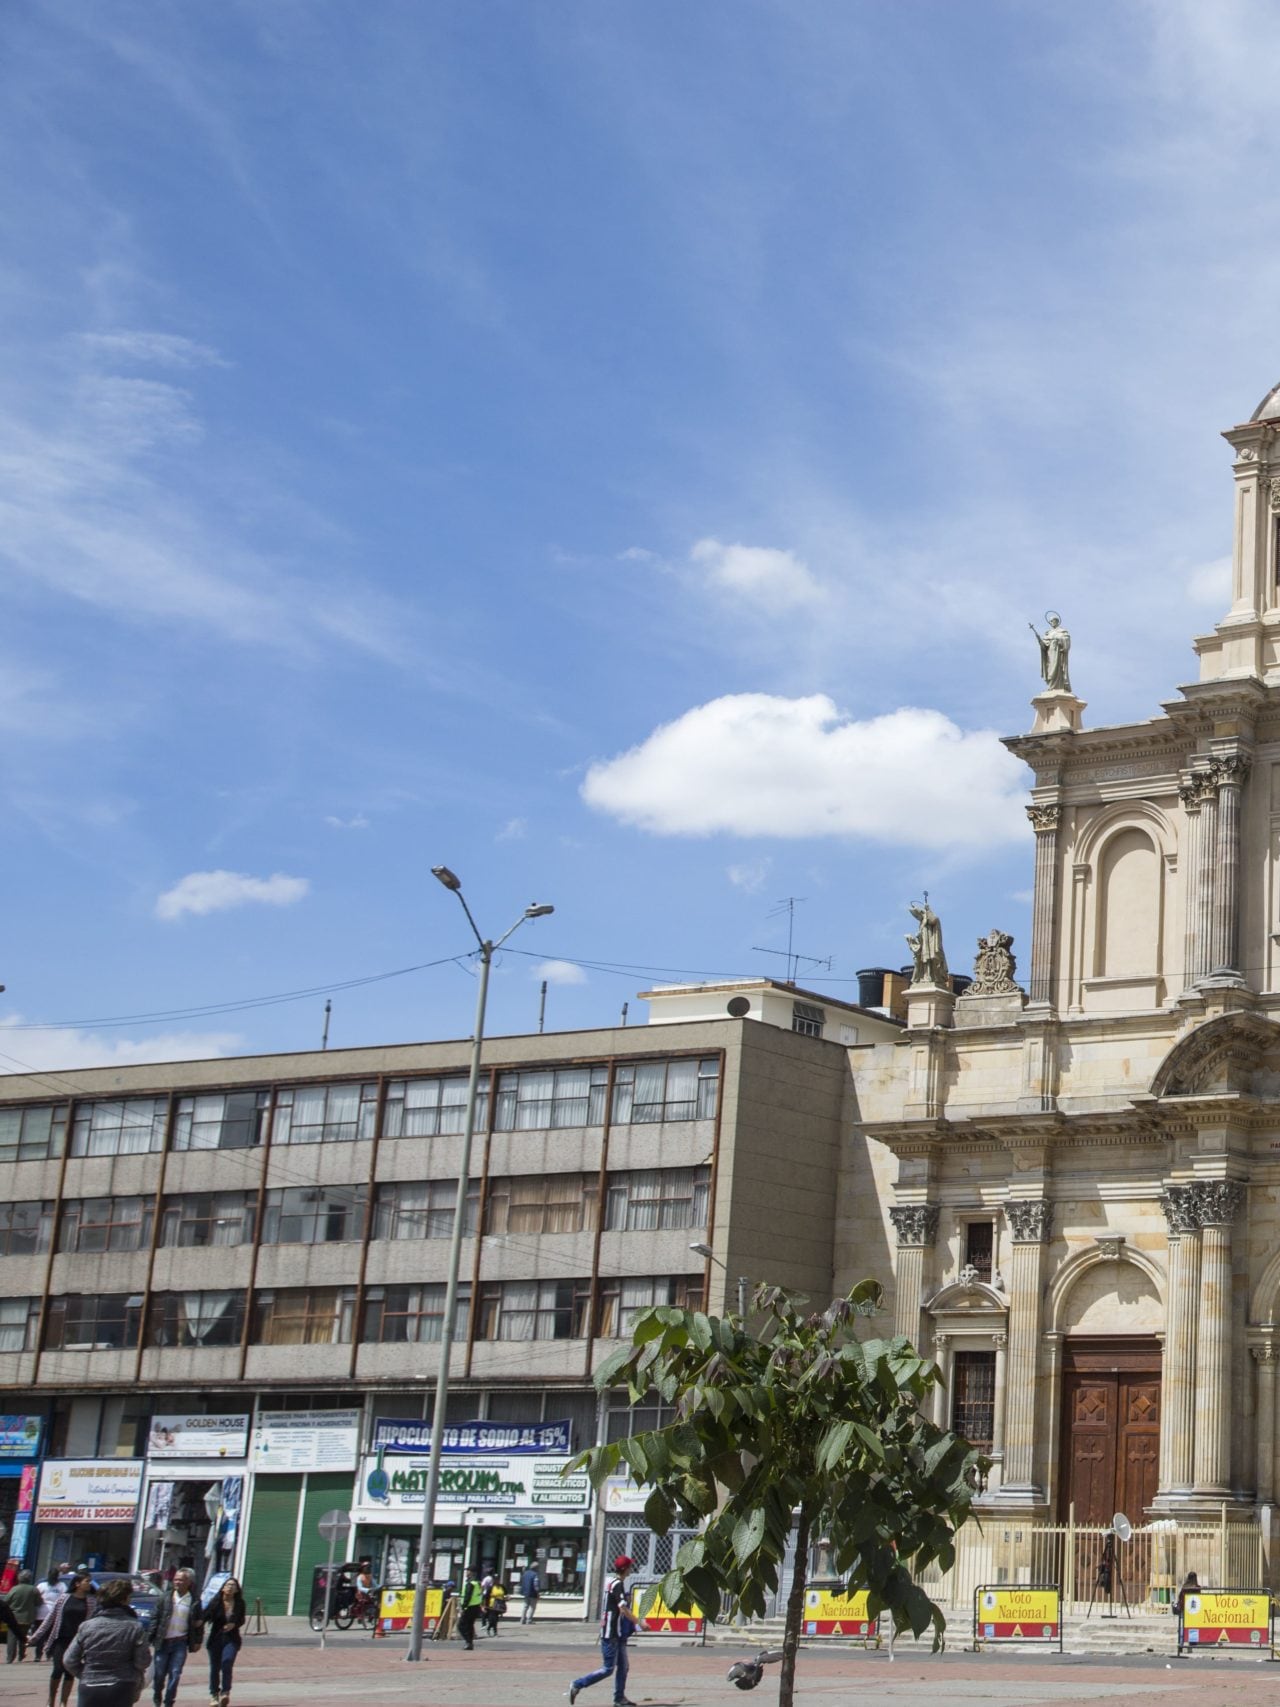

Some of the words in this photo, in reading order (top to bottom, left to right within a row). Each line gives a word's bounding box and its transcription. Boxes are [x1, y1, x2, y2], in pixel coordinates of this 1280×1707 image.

[186, 1418, 217, 1428] GOLDEN
[218, 1418, 245, 1427] HOUSE
[378, 1426, 458, 1447] HIPOCLOTO
[460, 1427, 476, 1448] DE
[478, 1428, 518, 1448] SODIO
[520, 1428, 536, 1446] AL
[538, 1426, 566, 1447] 15%
[392, 1470, 500, 1490] MATRQUIM
[540, 1494, 583, 1502] ALIMENTOS
[1009, 1591, 1032, 1604] Voto
[1215, 1594, 1238, 1608] Voto
[821, 1604, 866, 1617] Nacional
[998, 1605, 1047, 1619] Nacional
[1203, 1609, 1255, 1624] Nacional
